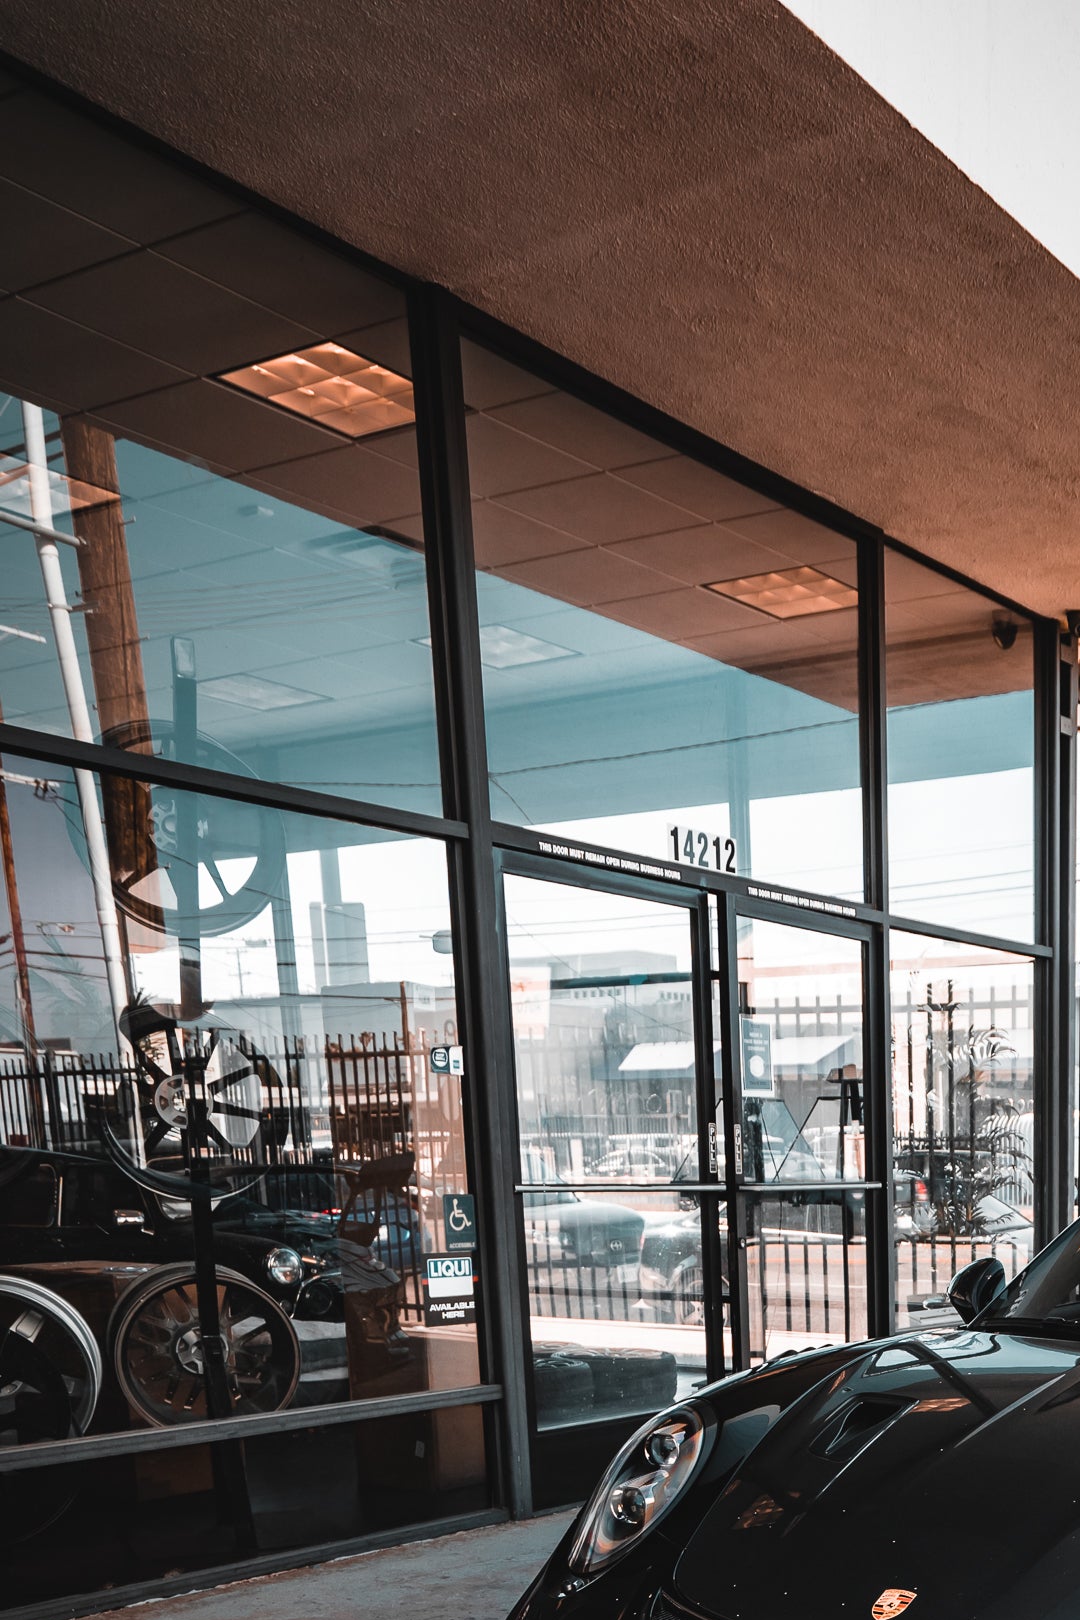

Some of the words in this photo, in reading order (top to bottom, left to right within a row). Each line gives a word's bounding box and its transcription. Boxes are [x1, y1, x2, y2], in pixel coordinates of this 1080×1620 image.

[670, 826, 736, 874] 14212
[539, 841, 551, 853] THIS
[553, 844, 568, 856] DOOR
[569, 848, 585, 859] MUST
[585, 851, 605, 864] REMAIN
[606, 856, 620, 867] OPEN
[621, 859, 639, 871] DURING
[640, 863, 663, 877] BUSINESS
[664, 868, 681, 880] HOURS
[430, 1260, 470, 1278] LIQUI
[429, 1301, 475, 1312] AVAILABLE
[441, 1310, 465, 1319] HERE
